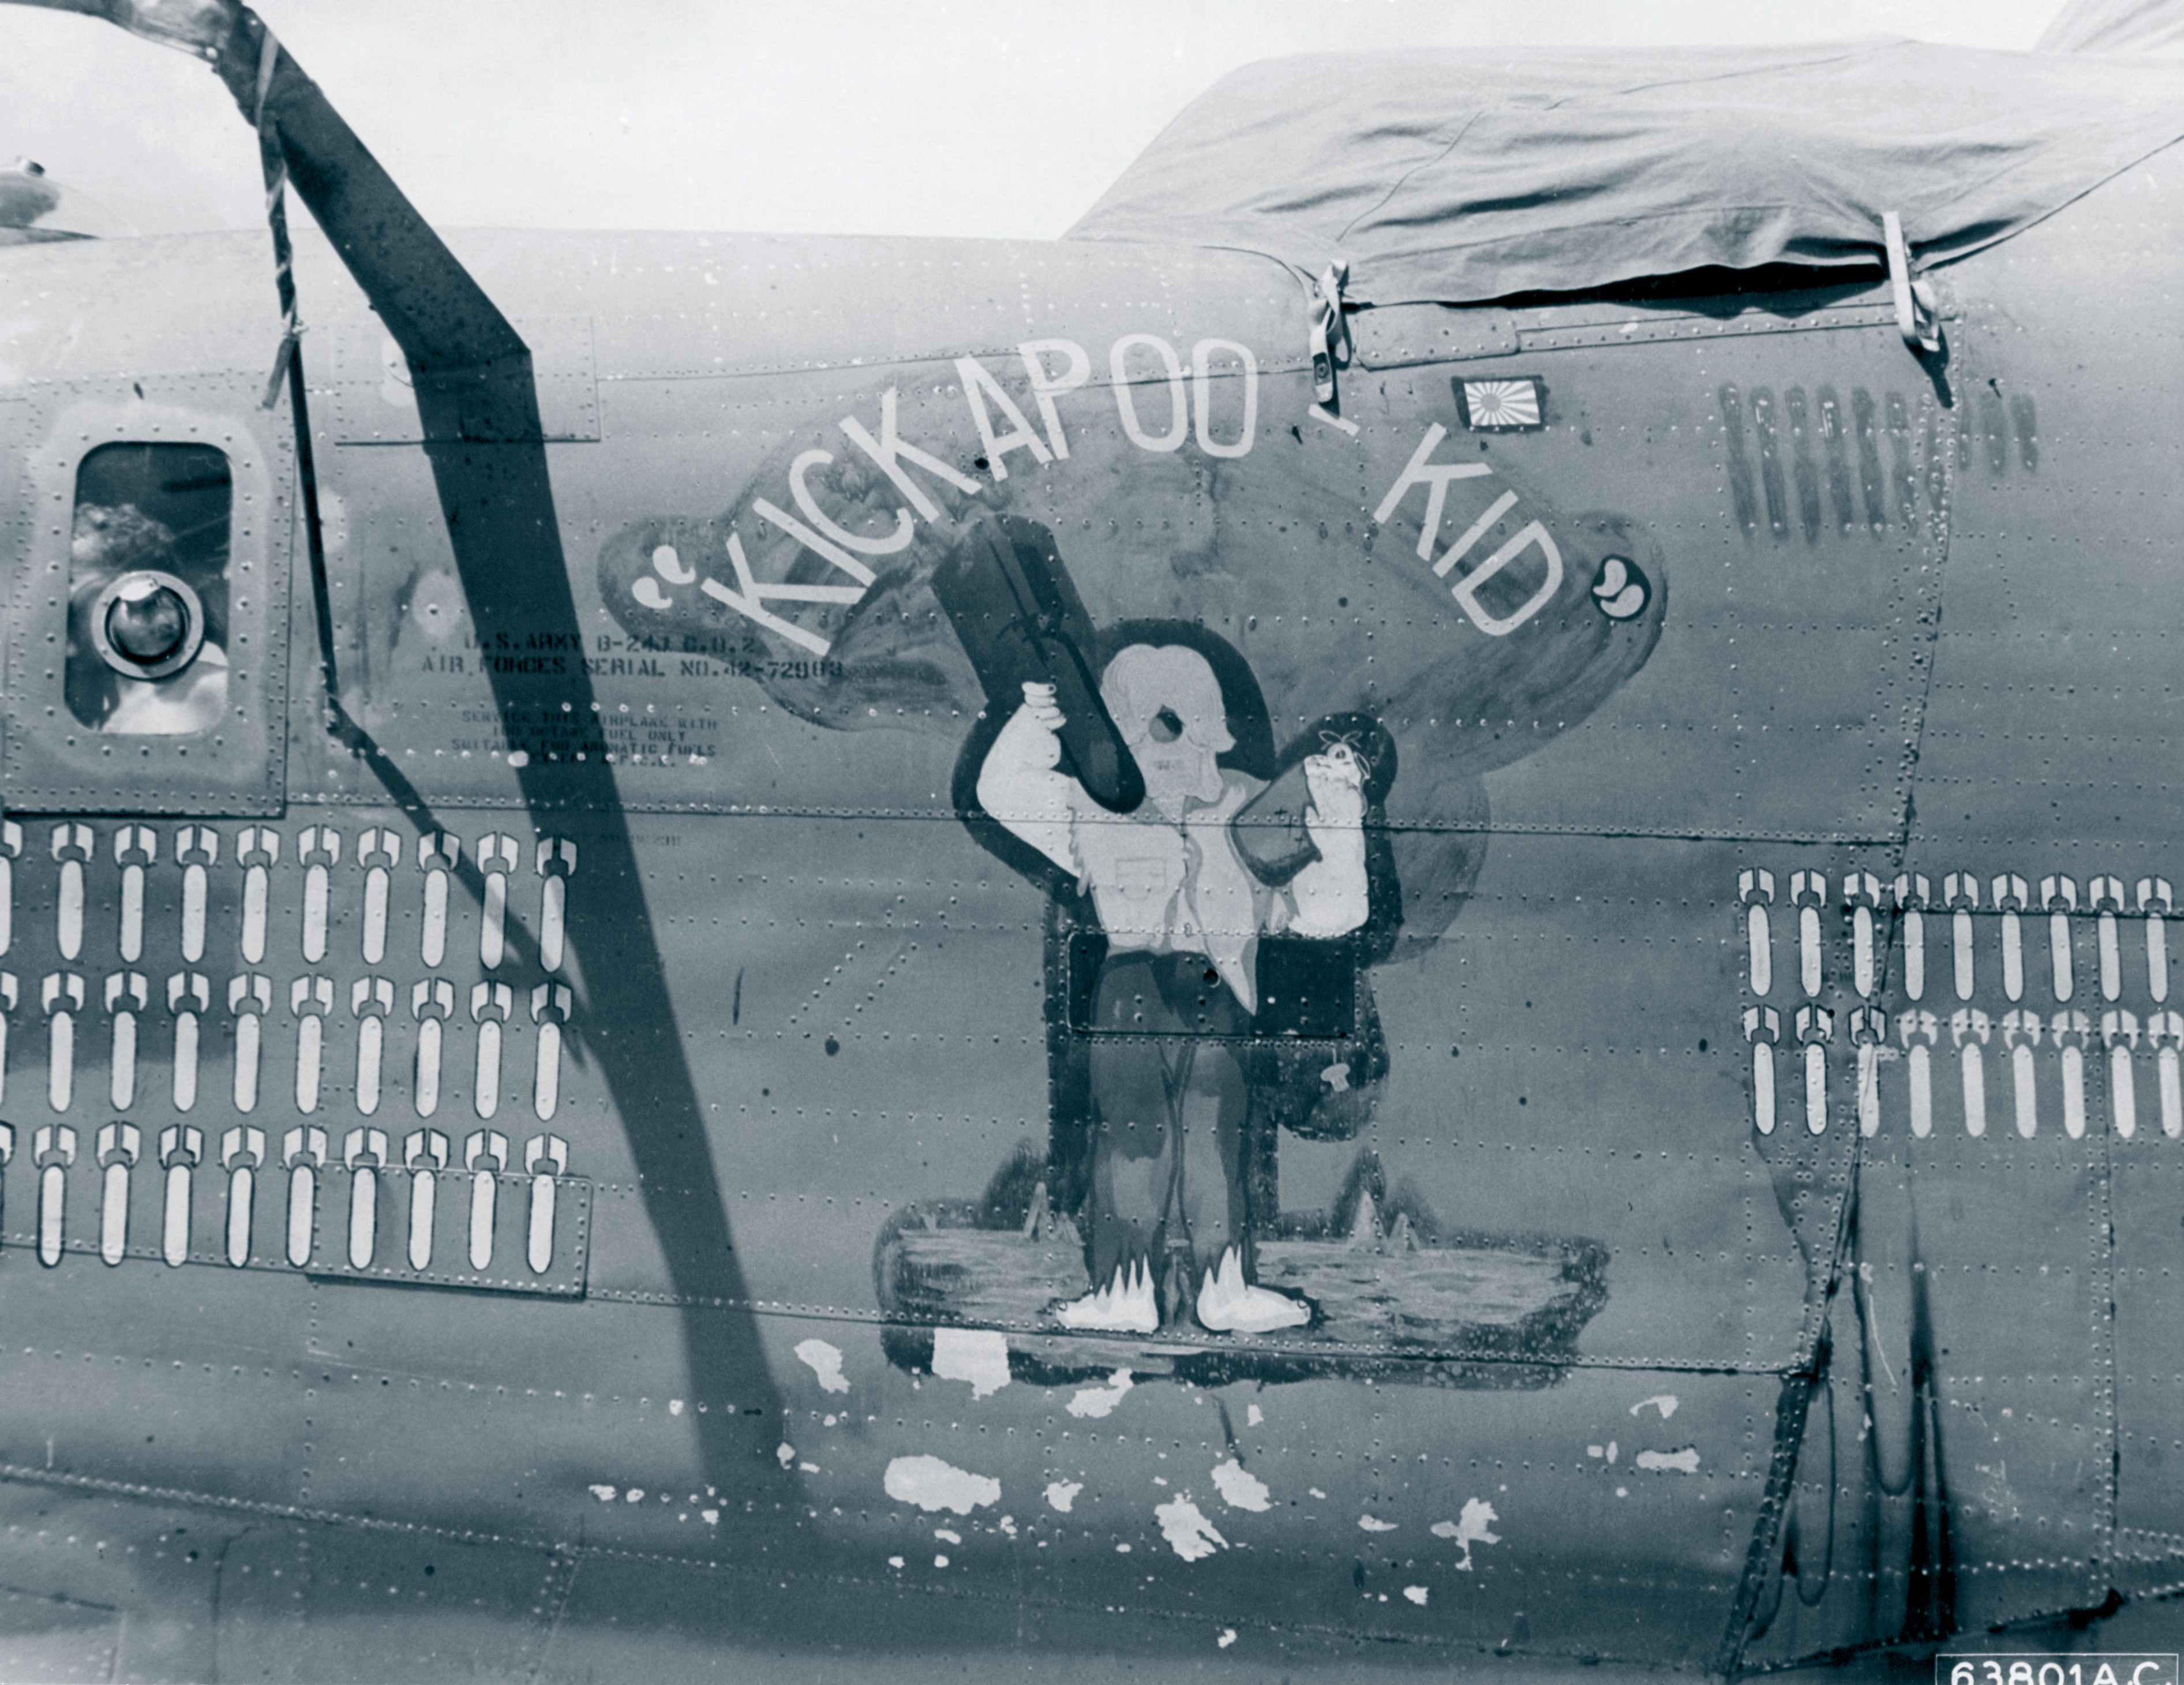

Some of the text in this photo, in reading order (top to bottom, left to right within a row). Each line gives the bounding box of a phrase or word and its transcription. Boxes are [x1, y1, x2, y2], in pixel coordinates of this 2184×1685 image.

[421, 654, 464, 673] AIR
[479, 654, 566, 675] FORCES
[580, 657, 666, 676] SERIAL
[591, 713, 668, 728] AIRPLANE
[678, 717, 718, 730] WITH
[599, 728, 636, 740] FUEL
[647, 730, 685, 742] ONLY
[668, 742, 717, 757] FUELS
